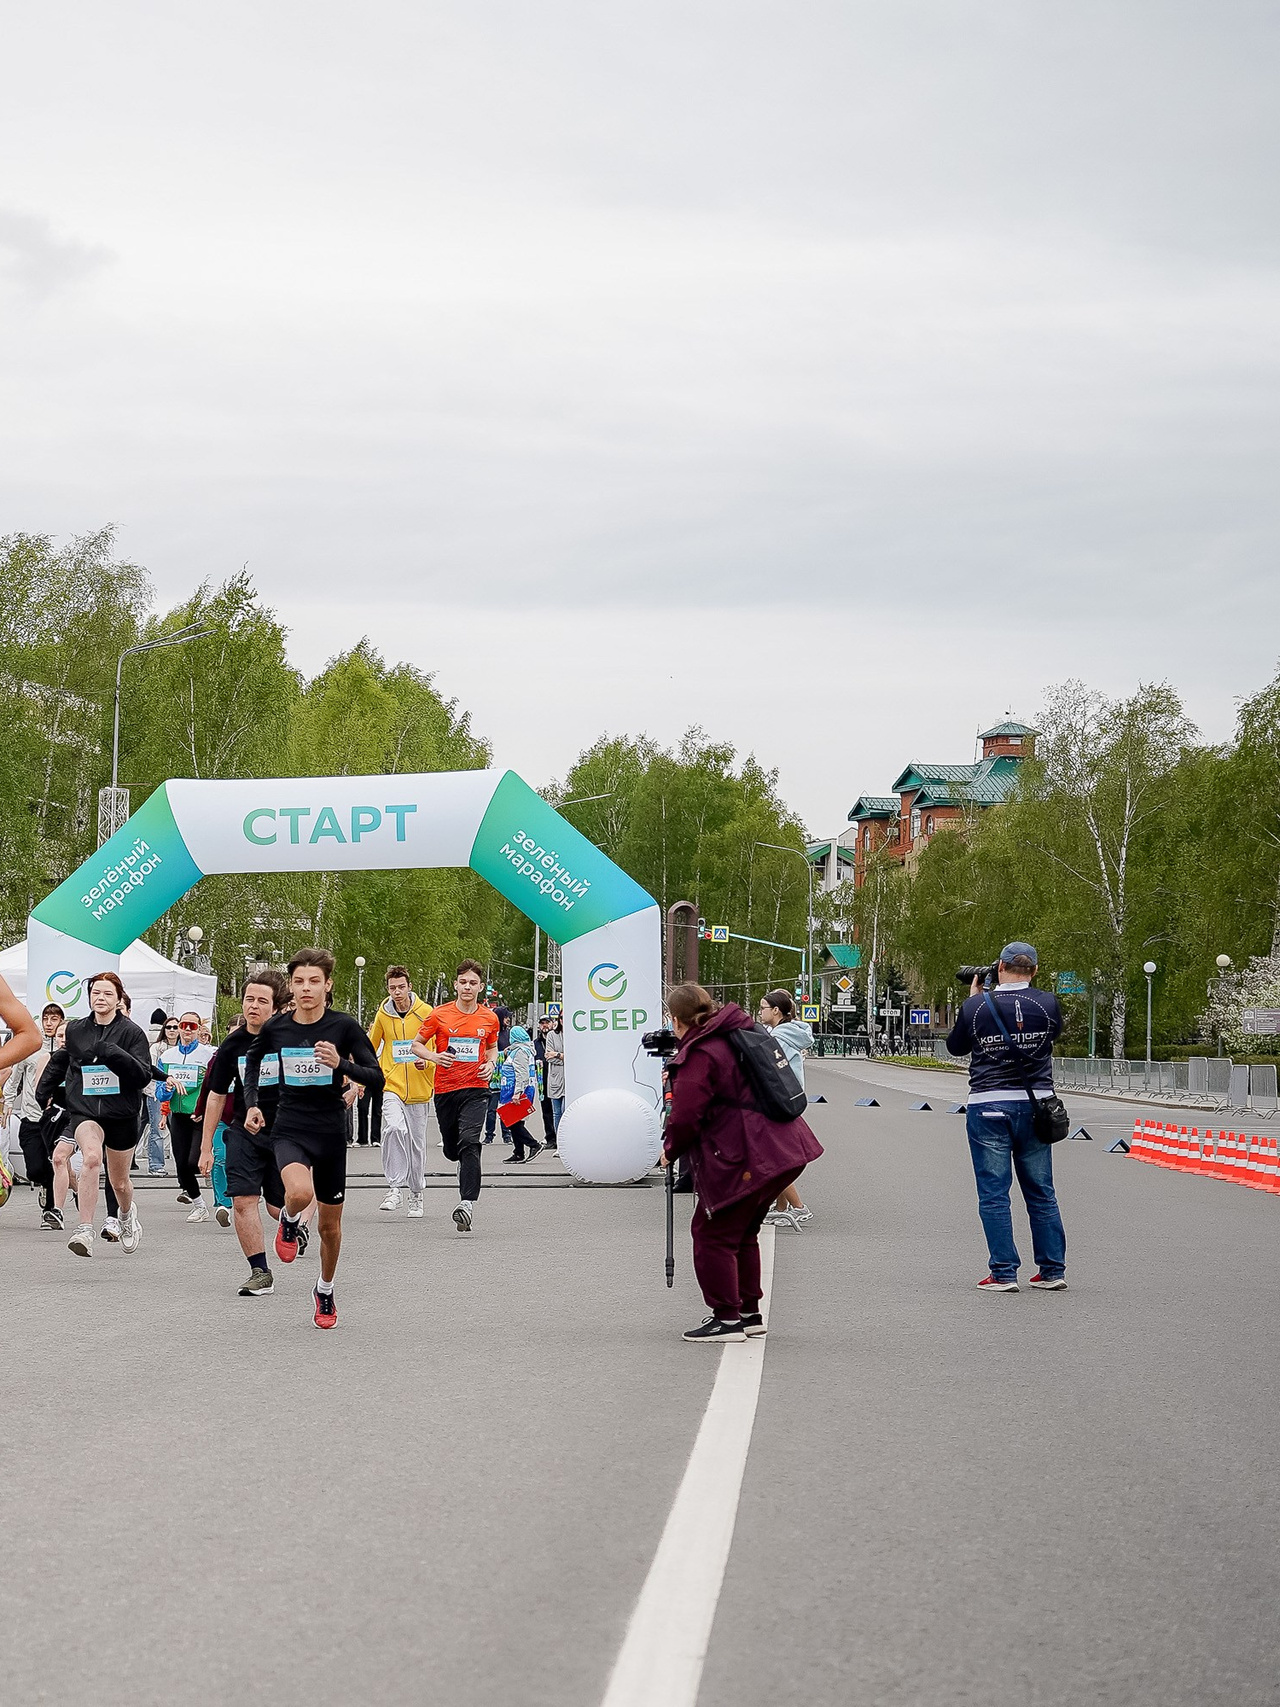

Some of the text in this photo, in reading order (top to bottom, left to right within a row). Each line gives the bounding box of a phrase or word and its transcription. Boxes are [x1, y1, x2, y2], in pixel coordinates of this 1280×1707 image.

[243, 804, 417, 845] СТАРТ
[80, 837, 150, 908] зелёный
[499, 843, 575, 911] марафон
[512, 830, 591, 898] зелёный
[91, 853, 163, 921] марафон
[572, 1009, 648, 1032] СБЕР
[980, 1031, 1046, 1044] КОСОПОРТ
[91, 1077, 110, 1085] 3377
[294, 1064, 320, 1073] 3365
